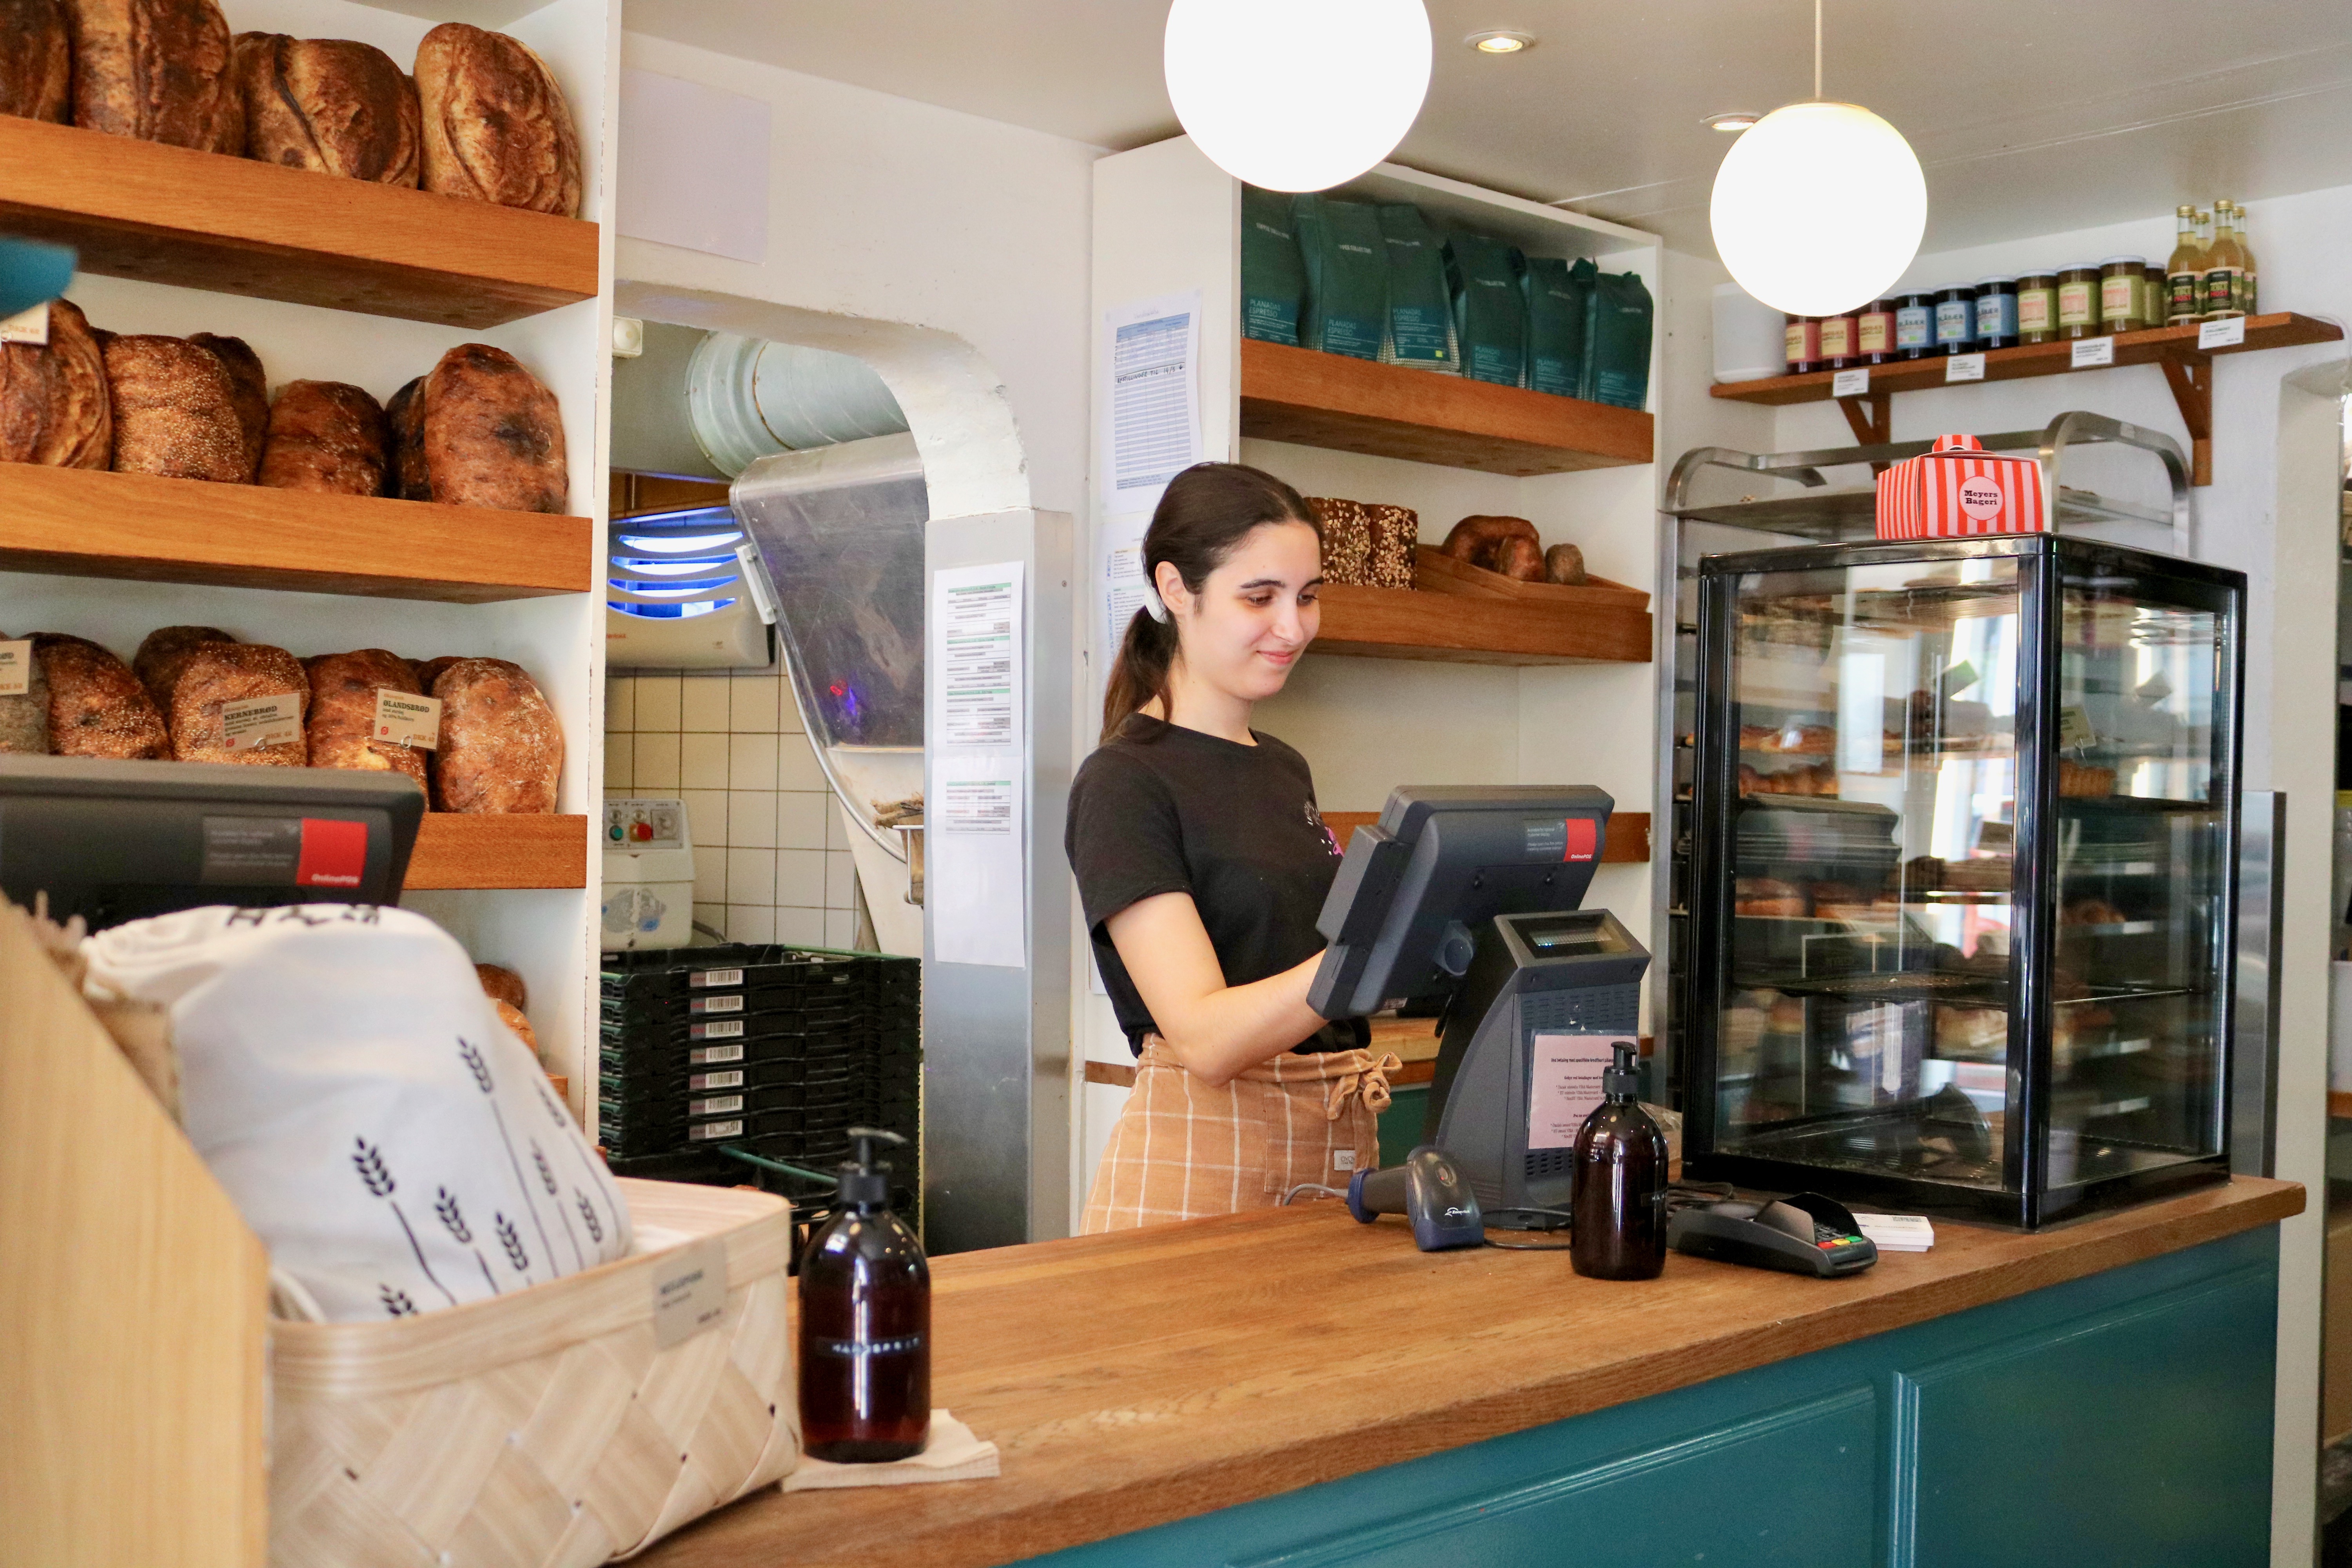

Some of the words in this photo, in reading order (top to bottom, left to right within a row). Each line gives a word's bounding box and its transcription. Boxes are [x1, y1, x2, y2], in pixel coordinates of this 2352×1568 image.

[1250, 299, 1281, 311] PLANADAS
[1249, 307, 1278, 318] ESPRESSO
[383, 700, 430, 713] ØLANDSBRØD
[225, 706, 278, 720] KERNEBRØD
